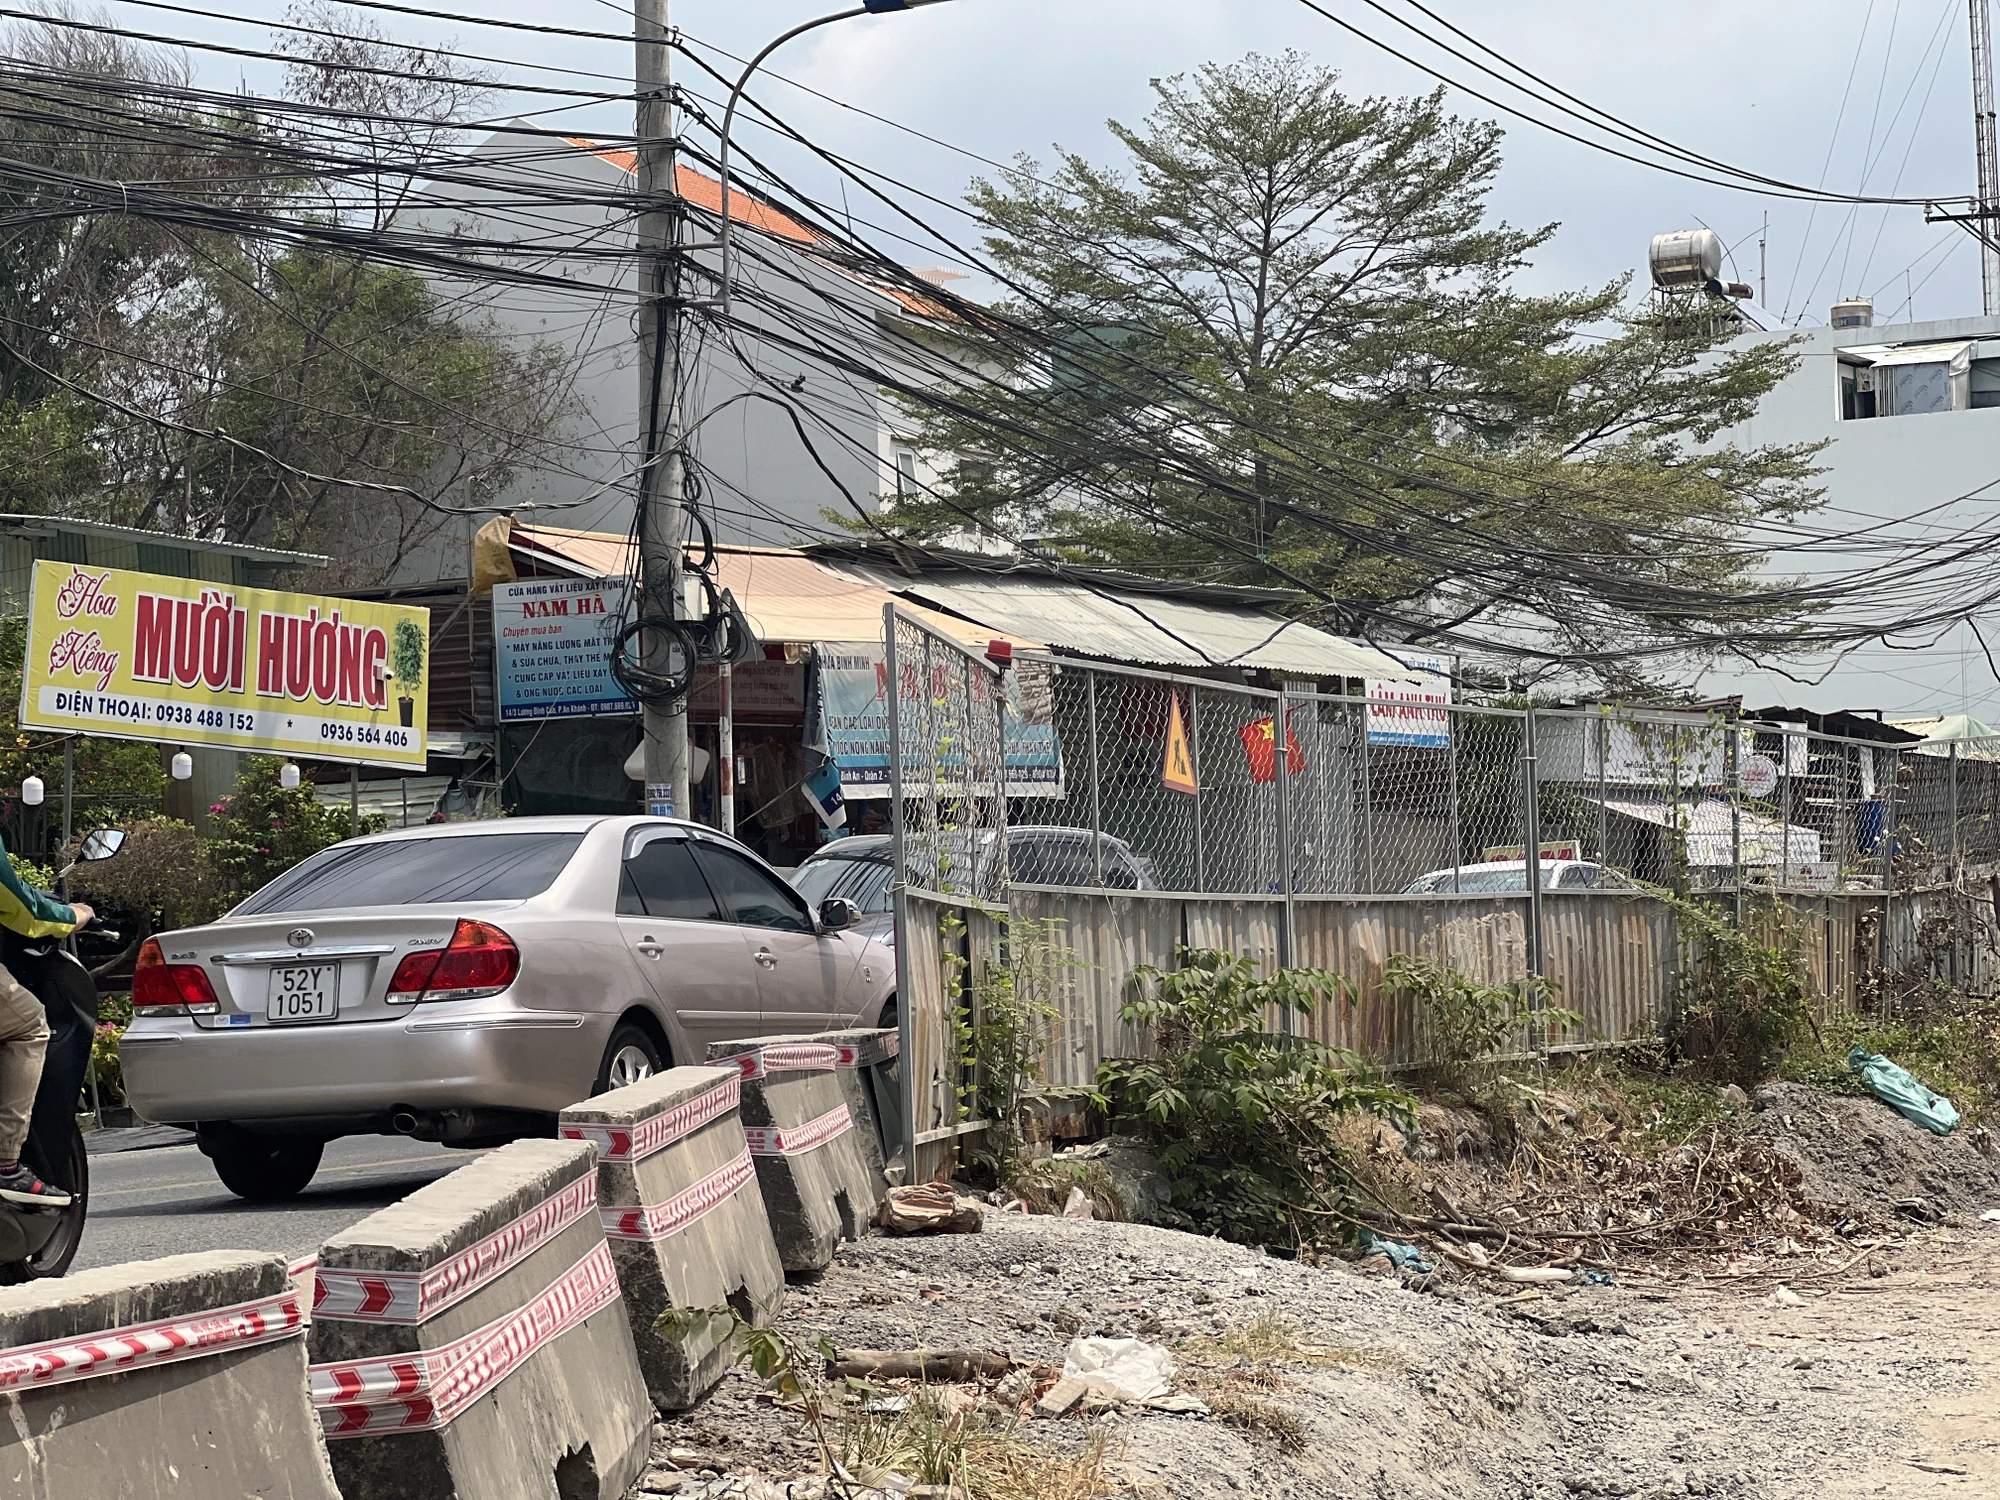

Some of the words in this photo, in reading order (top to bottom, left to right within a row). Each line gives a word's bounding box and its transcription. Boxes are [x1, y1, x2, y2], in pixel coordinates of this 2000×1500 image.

[57, 566, 117, 618] Hoa
[508, 585, 525, 597] CỬA
[526, 583, 548, 595] HÀNG
[549, 582, 564, 596] VẬT
[566, 581, 583, 594] LIỆU
[522, 600, 569, 619] NAM
[576, 593, 607, 615] HÀ
[531, 627, 547, 636] mua
[48, 631, 118, 691] Kiểng
[134, 590, 246, 690] MƯỜI
[257, 608, 388, 709] HƯƠNG
[514, 672, 536, 684] CUNG
[1370, 683, 1396, 718] LÂM
[1399, 692, 1423, 720] ANH
[56, 691, 95, 717] ĐIỆN
[99, 698, 151, 724] THOẠI:
[156, 705, 192, 725] 0938
[197, 709, 224, 728] 488
[229, 713, 254, 731] 152
[321, 723, 355, 742] 0936
[357, 727, 381, 745] 564
[384, 730, 409, 747] 406
[283, 967, 322, 992] 52Y
[277, 991, 323, 1016] 1051
